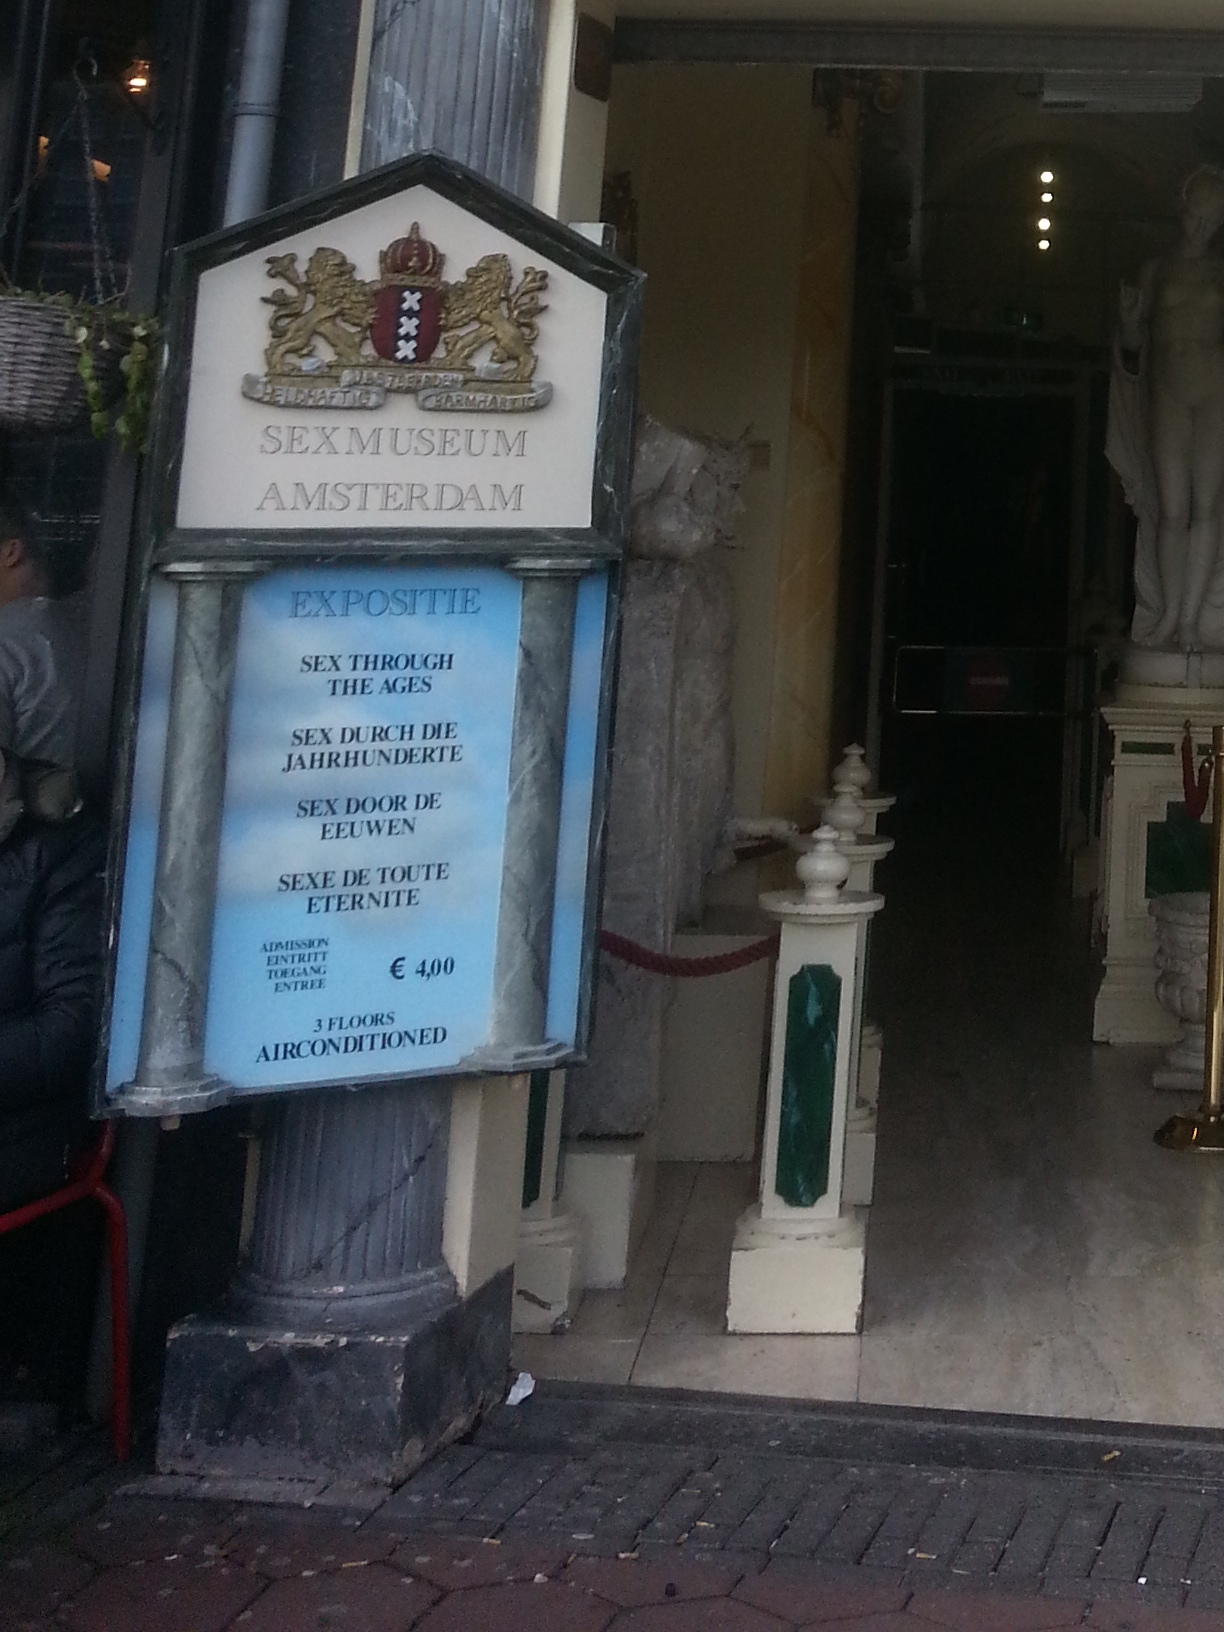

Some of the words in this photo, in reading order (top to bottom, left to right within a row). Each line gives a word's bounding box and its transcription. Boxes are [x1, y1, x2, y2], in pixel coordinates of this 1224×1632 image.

[434, 394, 537, 409] BARMHARTIG
[259, 425, 528, 457] SEXMUSEUM
[255, 483, 524, 511] AMSTERDAM
[289, 586, 482, 619] EXPOSITIE
[300, 654, 343, 674] SEX
[348, 652, 455, 673] THROUGH
[328, 677, 374, 696] THE
[379, 675, 432, 695] AGES
[291, 727, 333, 747] SEX
[339, 724, 415, 745] DURCH
[421, 722, 458, 742] DIE
[281, 744, 464, 774] JAHRHUNDERTE
[296, 799, 339, 818] SEX
[345, 795, 409, 815] DOOR
[415, 792, 443, 812] DE
[319, 817, 417, 841] EEUWEN
[277, 872, 336, 893] SEXE
[343, 868, 372, 888] DE
[377, 863, 450, 885] TOUTE
[305, 888, 420, 915] ETERNITE
[260, 937, 330, 954] ADMISSION
[266, 951, 328, 966] EINTRITT
[389, 957, 406, 981] €
[415, 956, 456, 979] 4,00
[266, 965, 327, 980] TOEGANG
[273, 978, 326, 994] ENTREE
[313, 1018, 324, 1033] 3
[327, 1012, 396, 1031] FLOORS
[255, 1027, 448, 1065] AIRCONDITIONED
